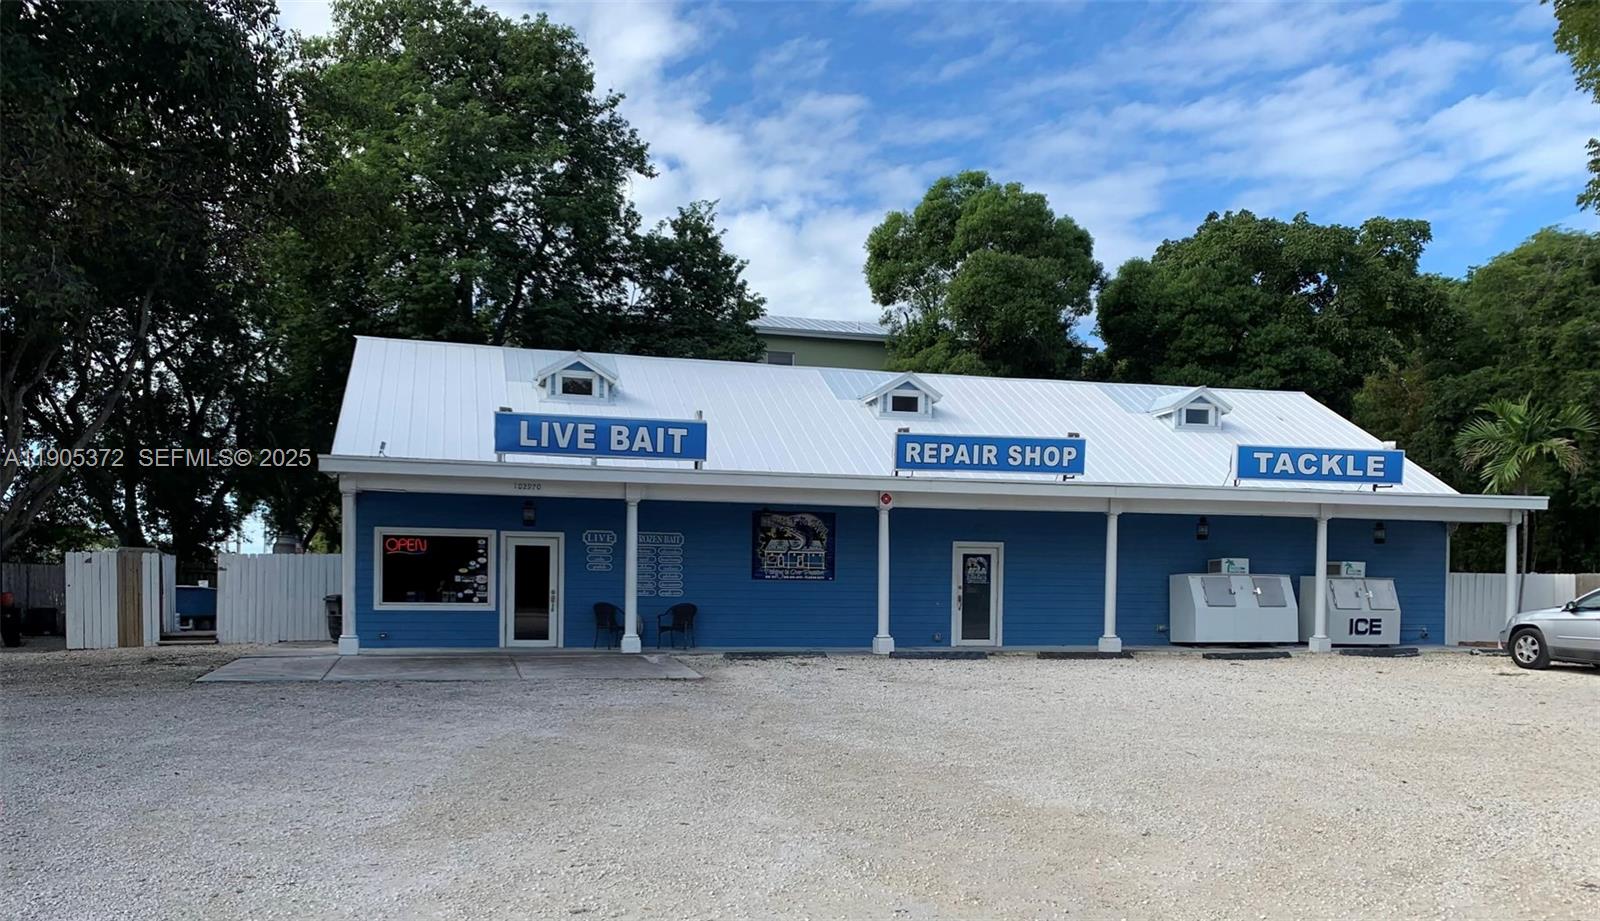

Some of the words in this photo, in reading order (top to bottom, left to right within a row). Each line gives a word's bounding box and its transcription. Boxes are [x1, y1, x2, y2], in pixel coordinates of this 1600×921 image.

[519, 420, 597, 450] LIVE
[610, 425, 688, 454] BAIT
[905, 442, 998, 465] REPAIR
[1007, 444, 1077, 468] SHOP
[1252, 451, 1385, 477] TACKLE
[385, 537, 427, 552] OPEN
[587, 533, 614, 542] LIVE
[638, 534, 663, 544] ROZEN
[664, 535, 680, 544] BAIT
[1349, 618, 1382, 636] ICE
